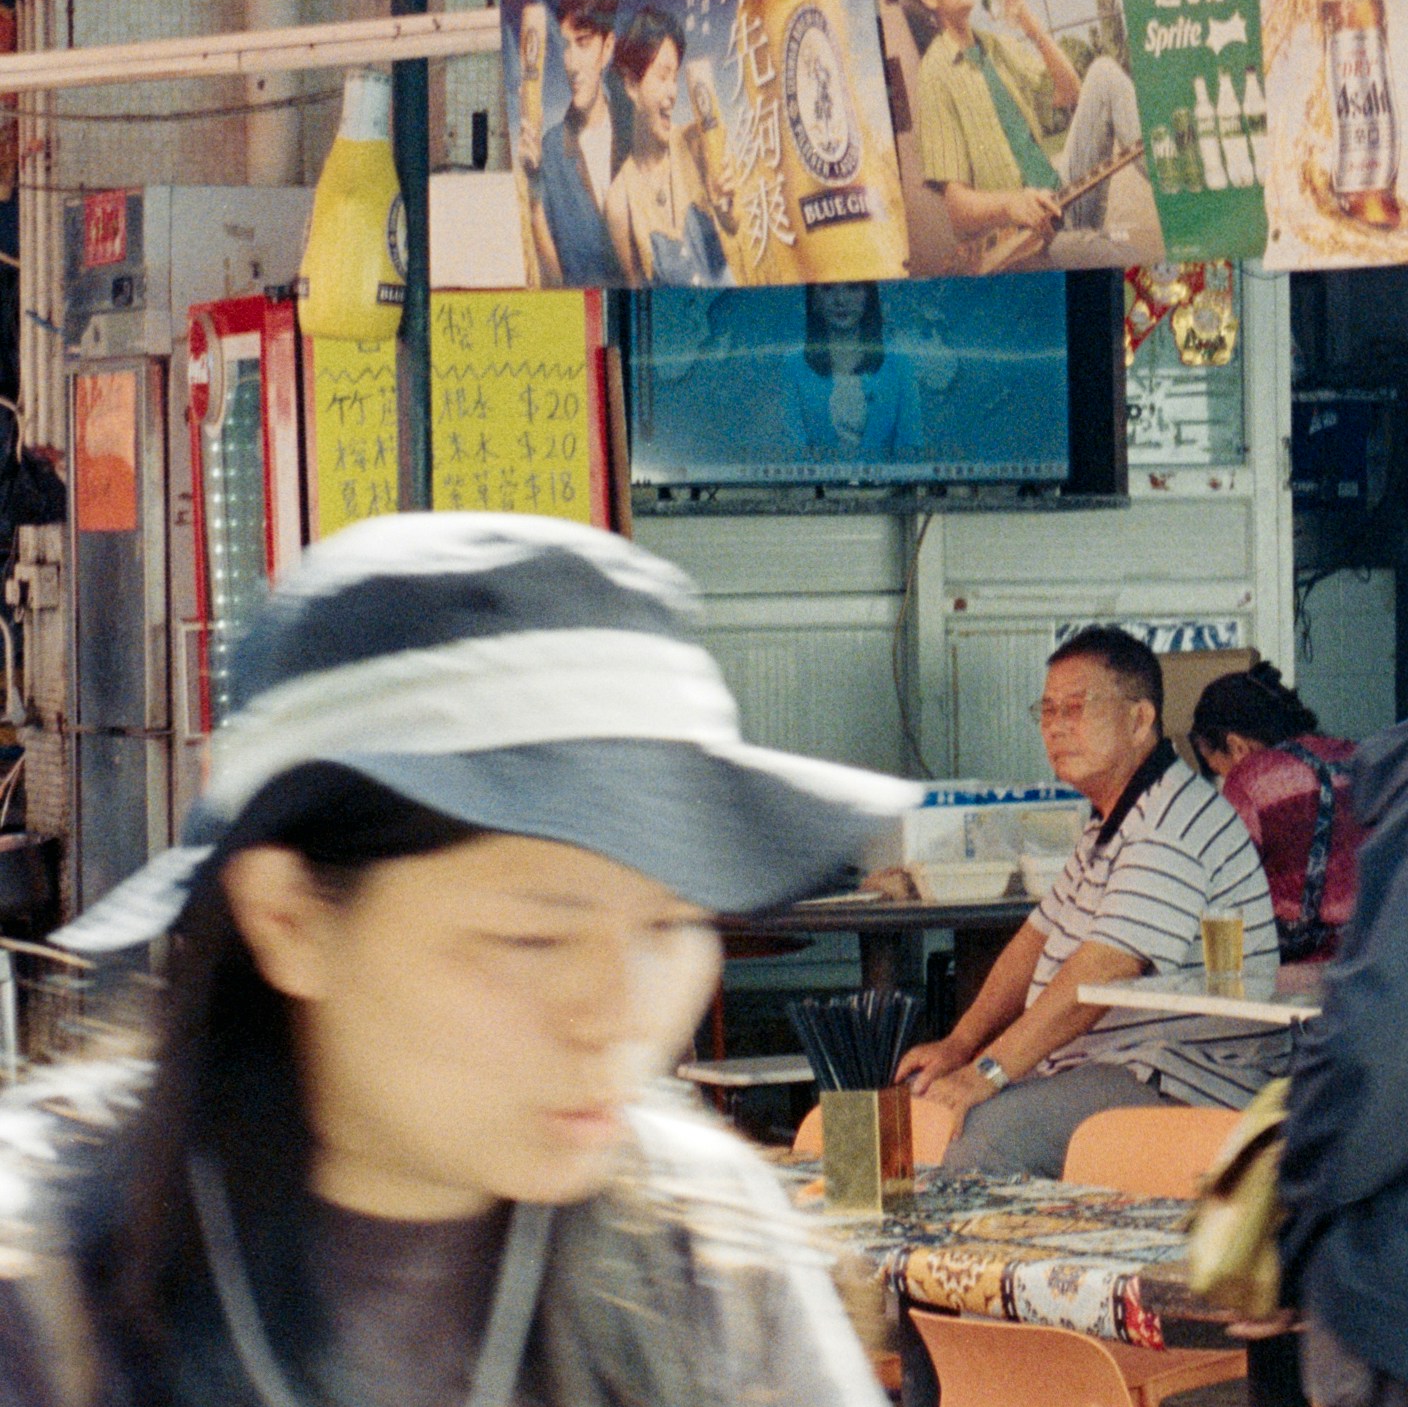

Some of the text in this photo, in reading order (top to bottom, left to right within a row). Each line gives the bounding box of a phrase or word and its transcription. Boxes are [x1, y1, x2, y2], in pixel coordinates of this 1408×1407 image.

[1145, 15, 1202, 59] Sprite
[803, 196, 847, 227] BLUE
[518, 383, 579, 425] $20
[516, 431, 577, 462] $20
[525, 471, 578, 510] $18
